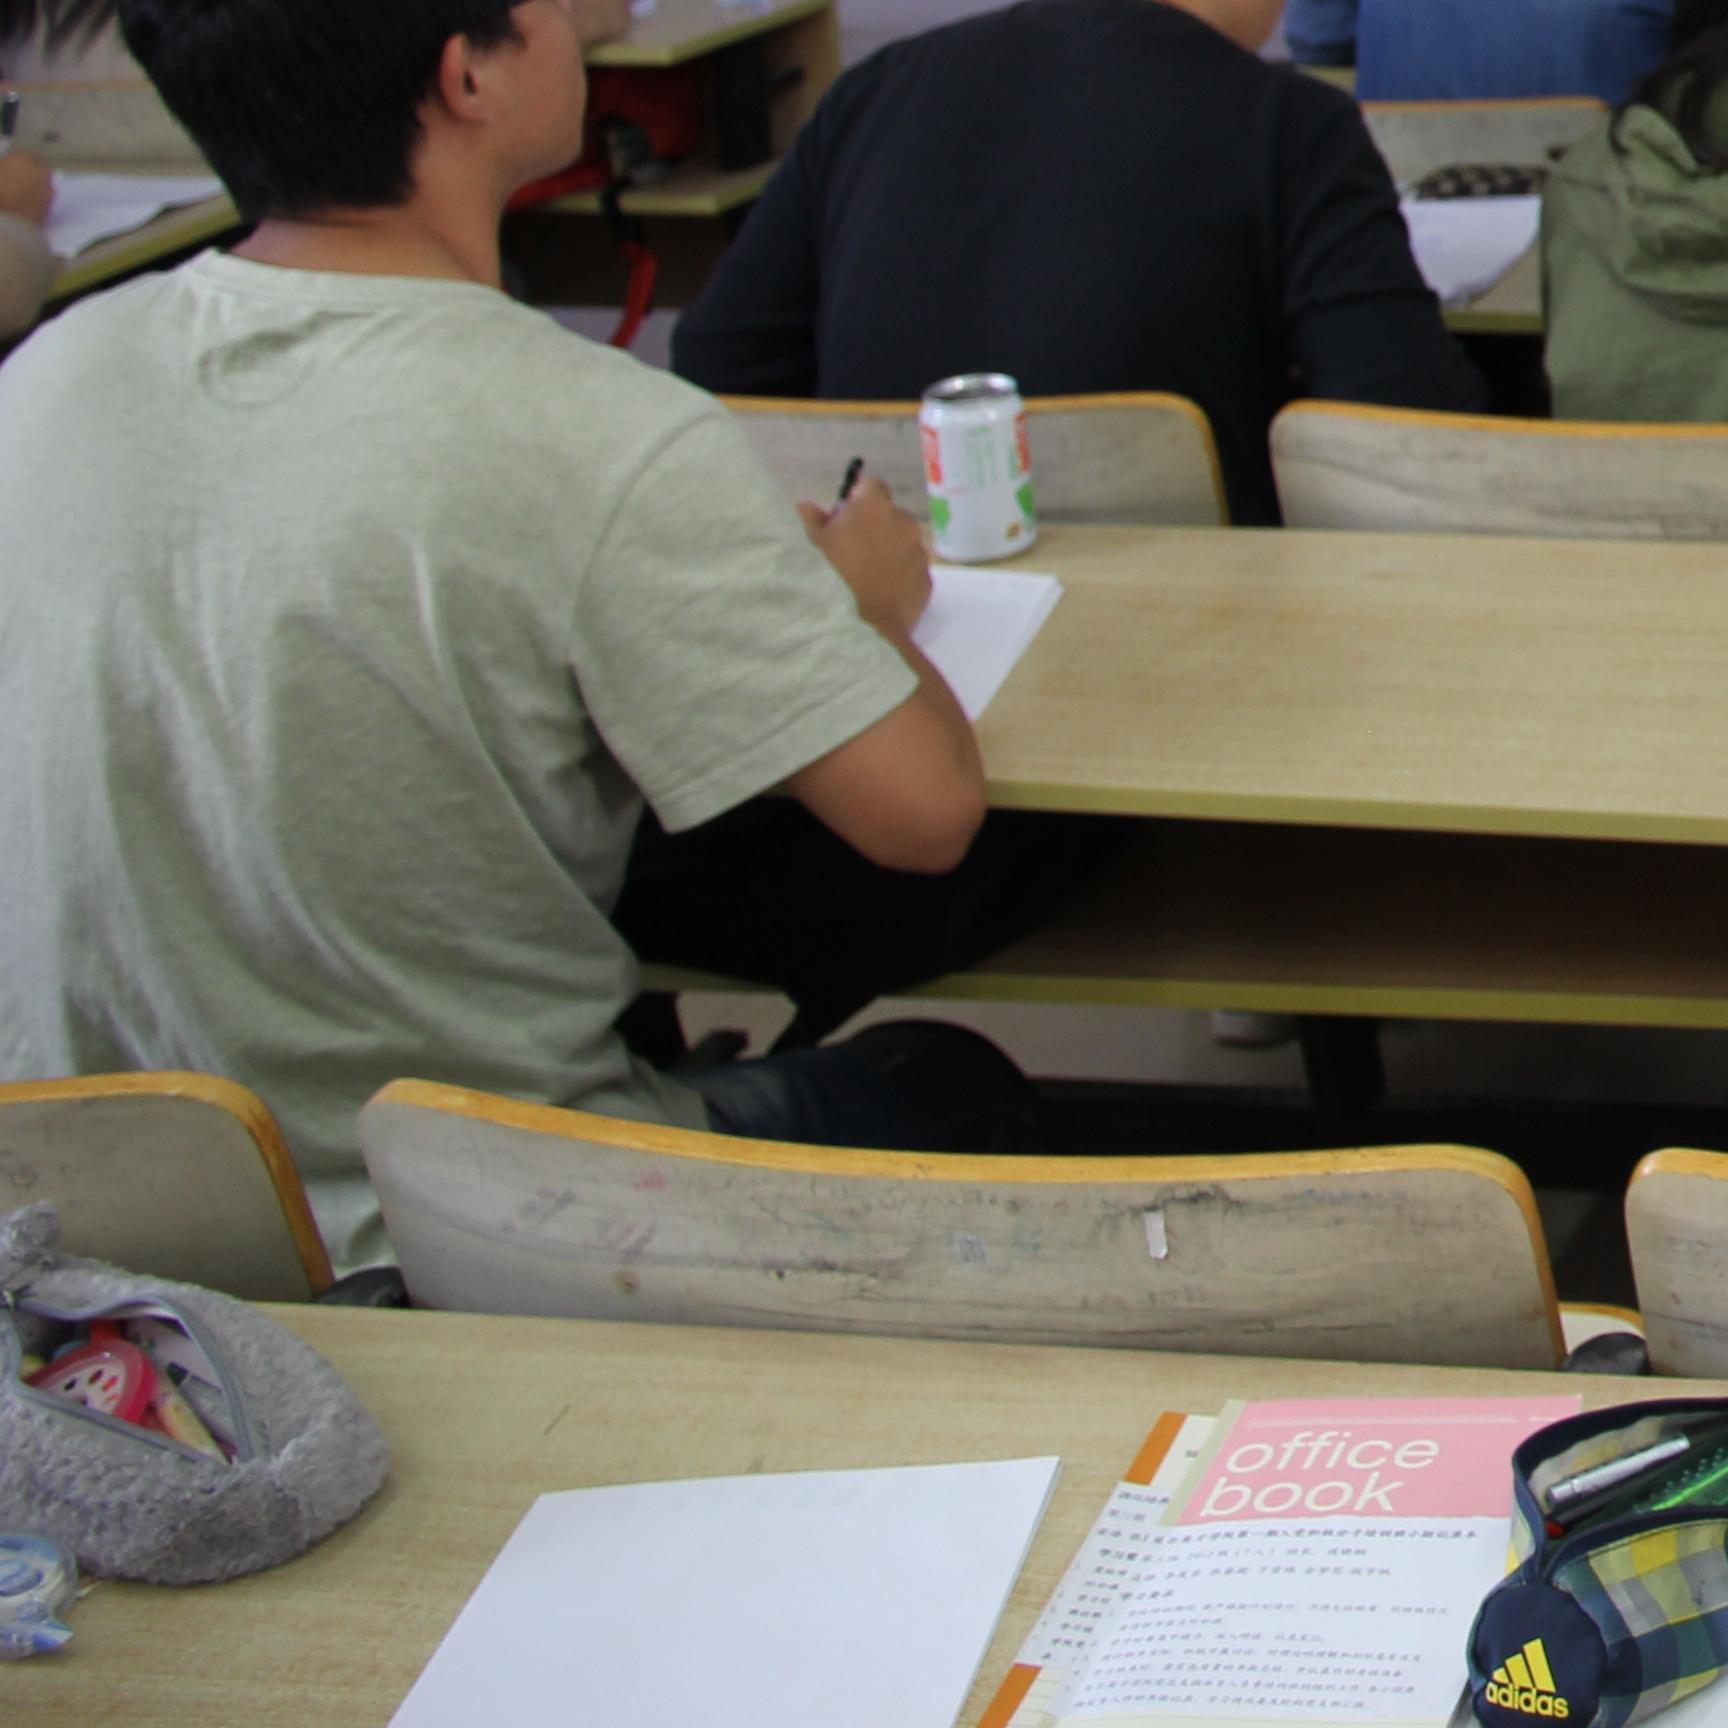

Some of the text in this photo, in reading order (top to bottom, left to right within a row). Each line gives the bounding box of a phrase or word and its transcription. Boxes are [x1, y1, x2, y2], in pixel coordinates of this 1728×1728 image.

[1226, 1430, 1440, 1473] office
[1199, 1471, 1404, 1517] book
[1485, 1681, 1570, 1719] adidas
